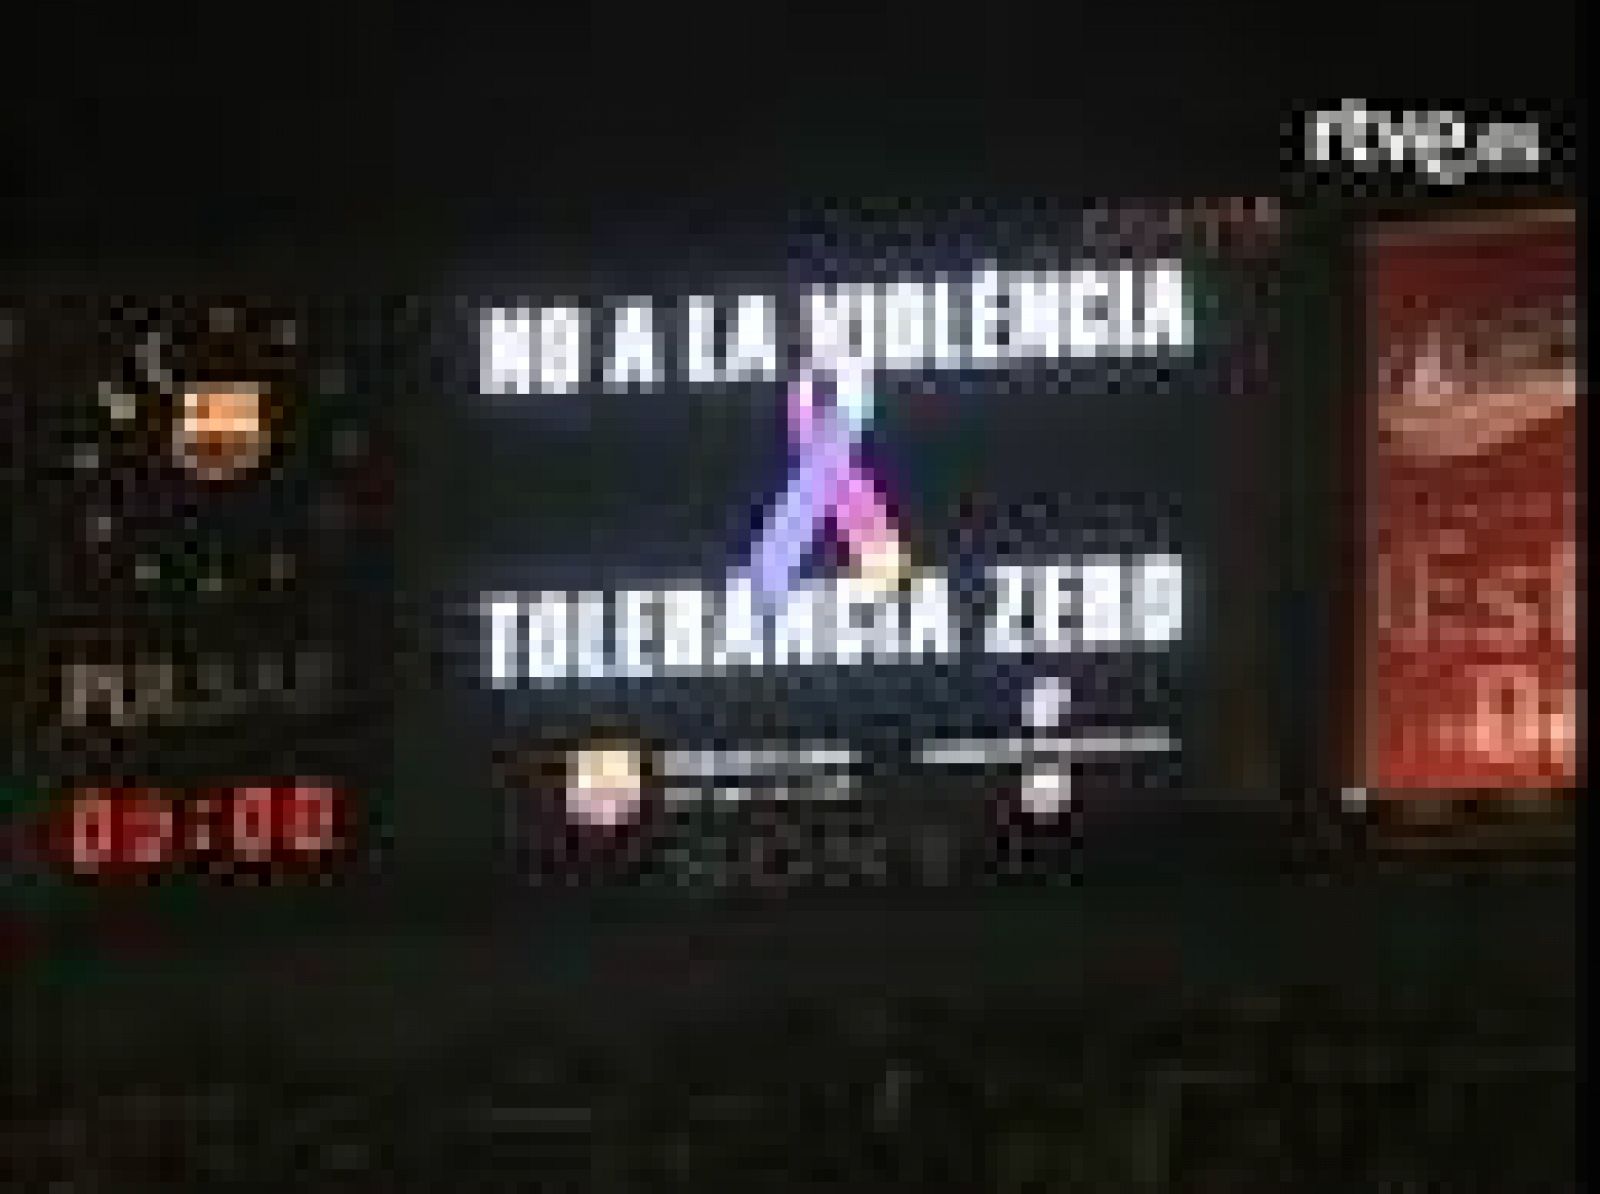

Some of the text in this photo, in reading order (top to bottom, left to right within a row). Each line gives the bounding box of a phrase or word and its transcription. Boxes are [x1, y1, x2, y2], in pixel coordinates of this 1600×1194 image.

[480, 305, 584, 394] NO
[603, 296, 662, 382] A
[688, 296, 778, 382] LA
[984, 554, 1183, 652] ZERO
